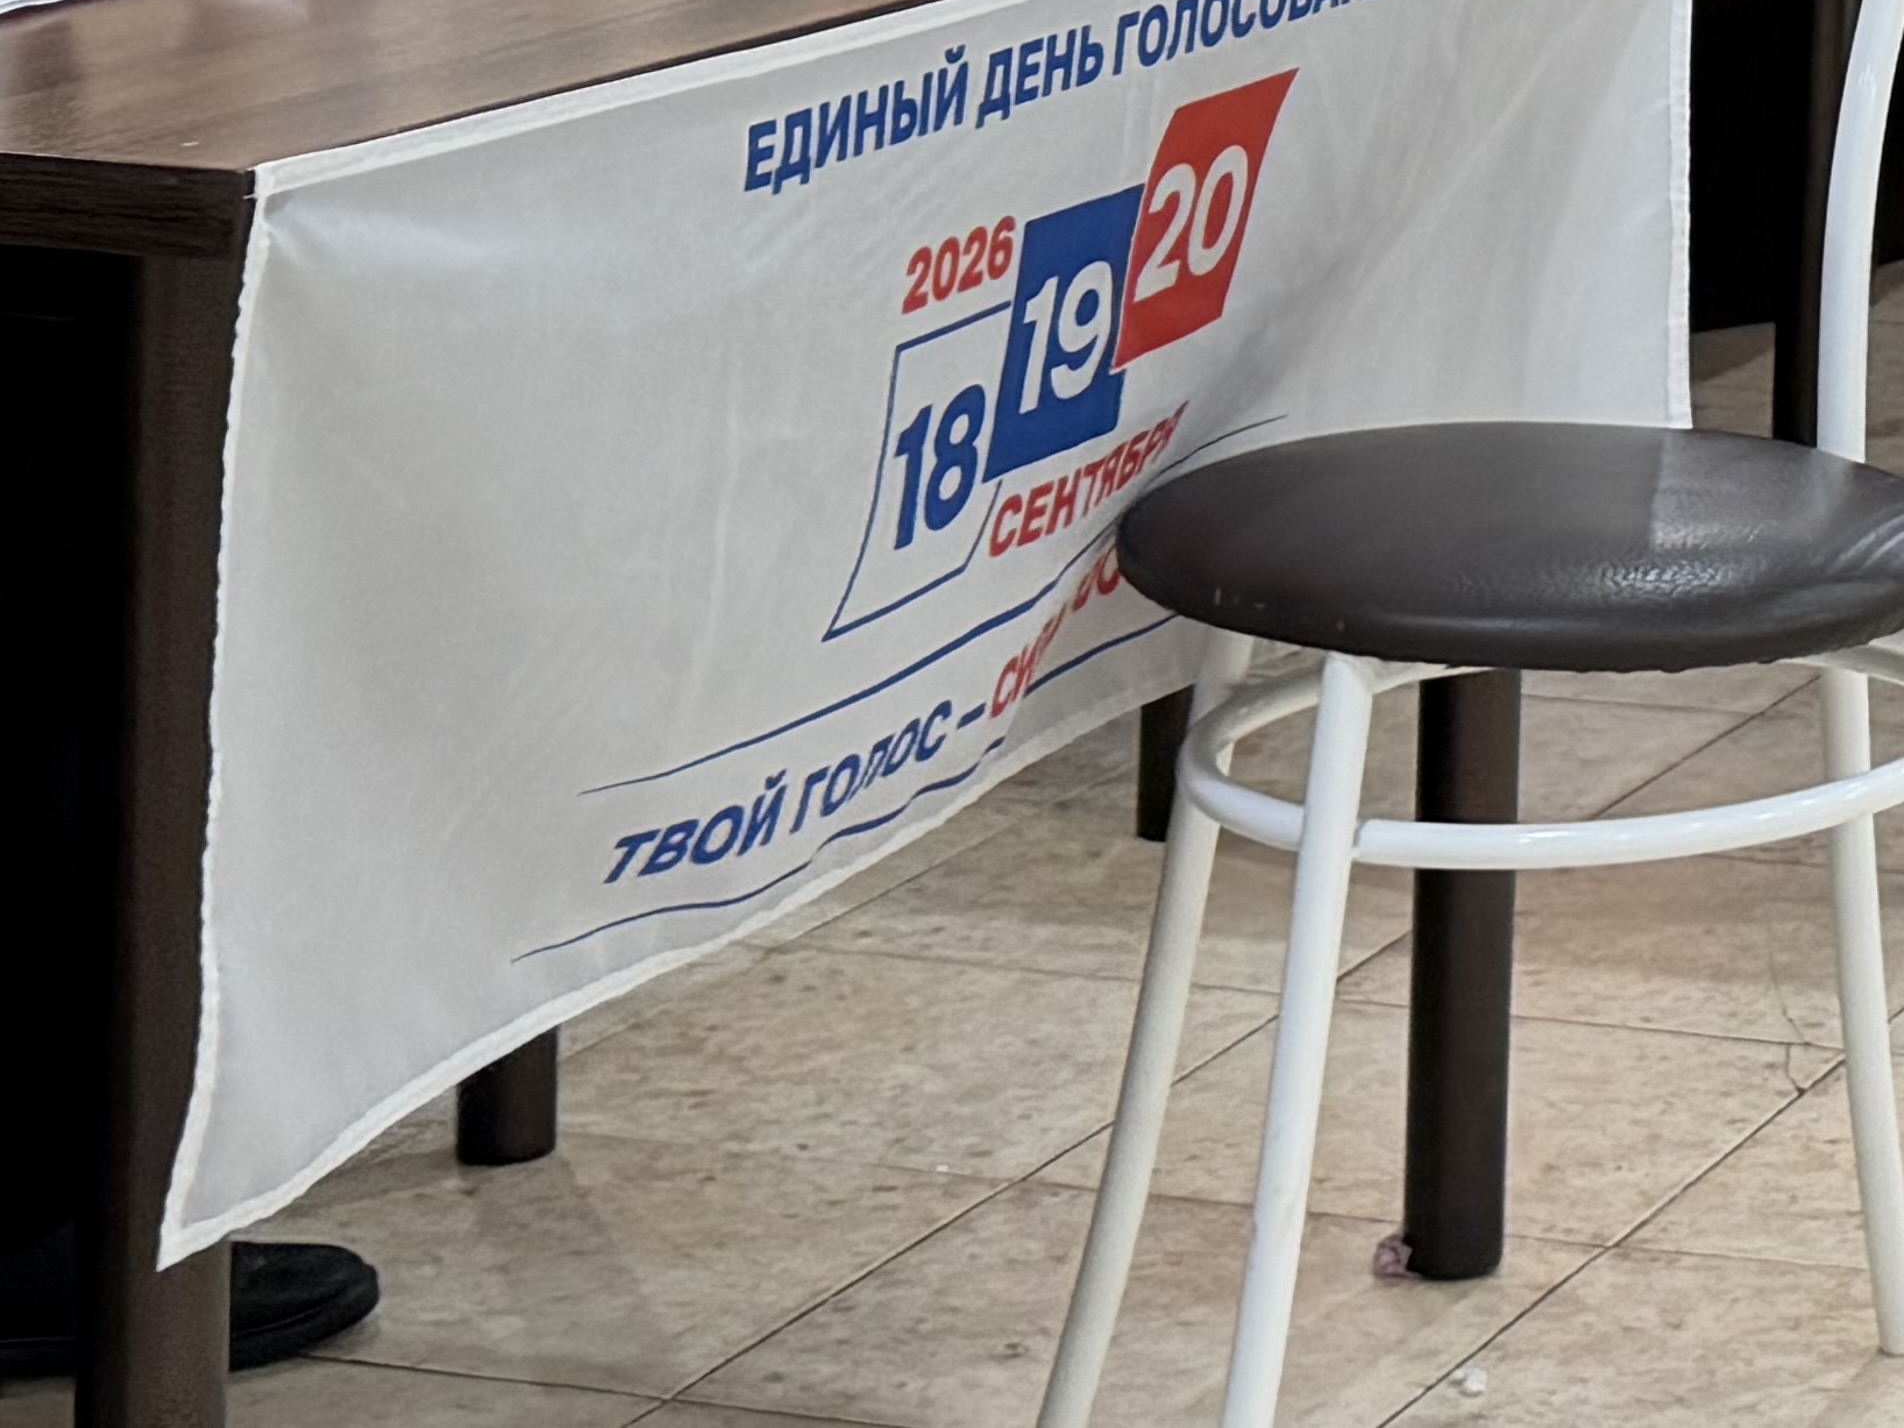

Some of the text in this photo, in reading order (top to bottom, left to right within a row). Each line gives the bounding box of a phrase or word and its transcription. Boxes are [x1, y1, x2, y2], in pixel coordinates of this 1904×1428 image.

[744, 45, 969, 195] ЕДИНЫЙ
[976, 24, 1101, 128] ДЕНЬ
[894, 145, 1248, 548] 18 19 20
[902, 215, 1016, 315] 2026
[989, 400, 1189, 557] СЕНТЯБРЯ
[602, 769, 788, 884] ТВОЙ
[790, 699, 952, 835] ГОЛОС
